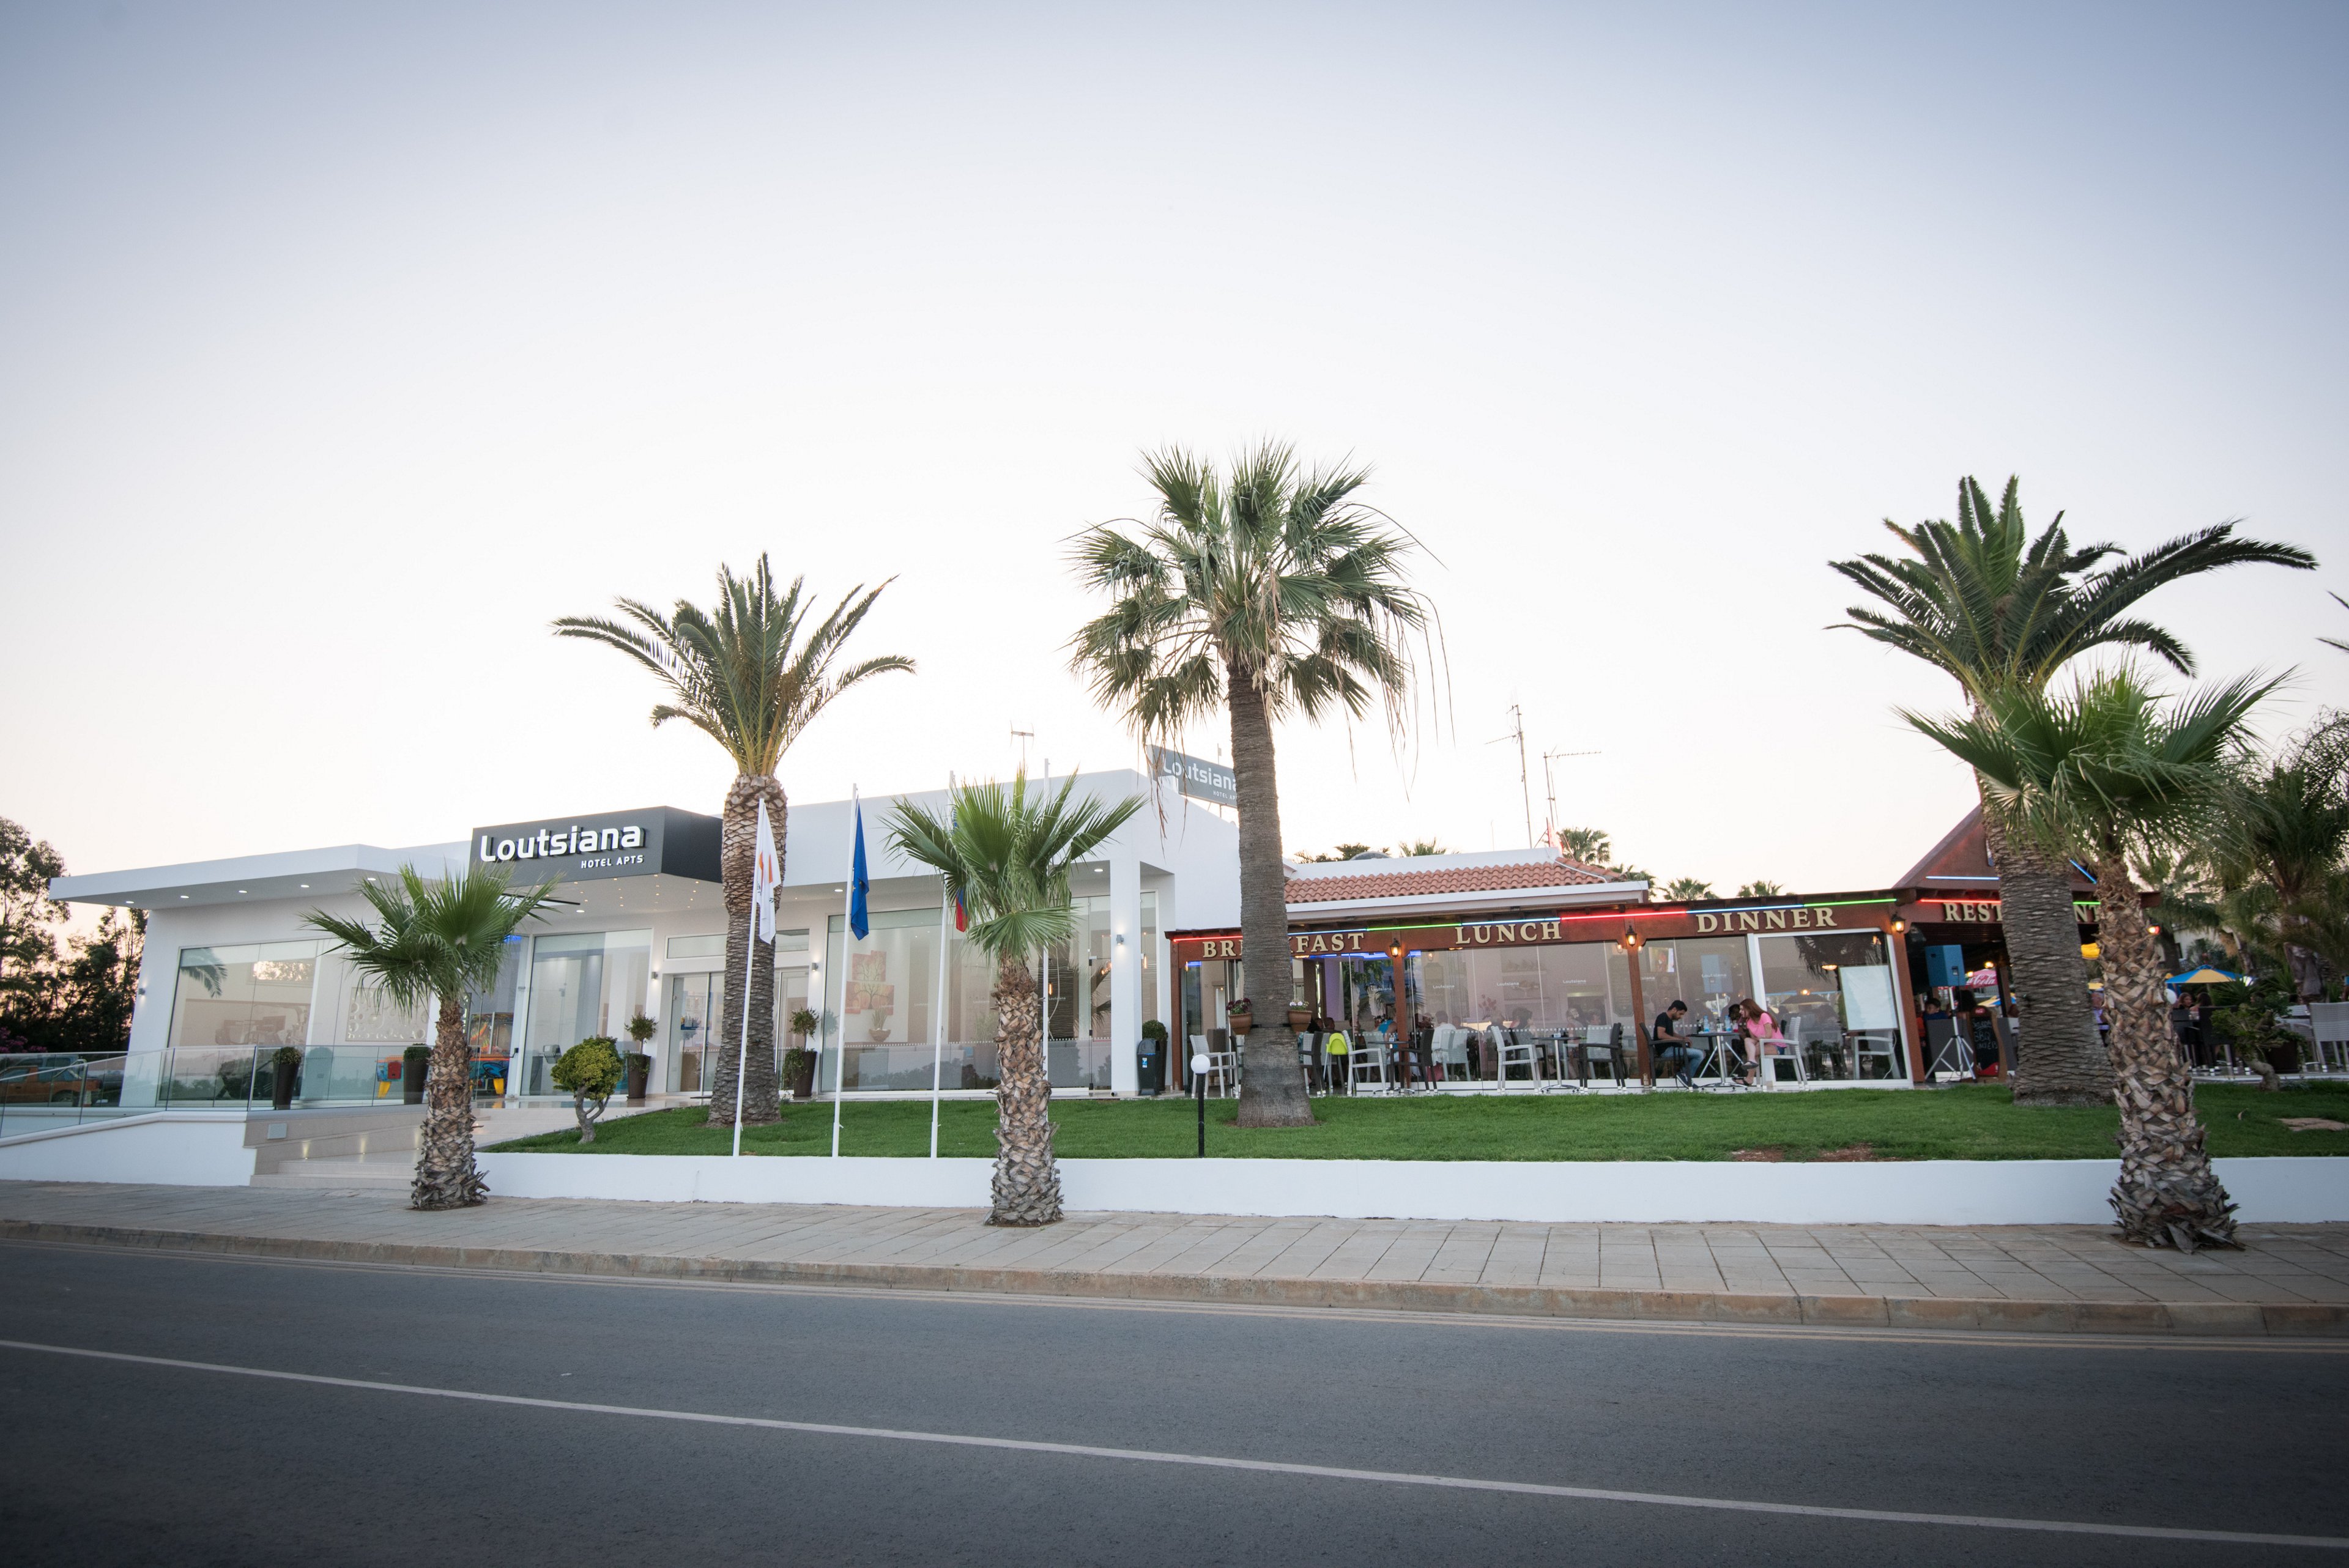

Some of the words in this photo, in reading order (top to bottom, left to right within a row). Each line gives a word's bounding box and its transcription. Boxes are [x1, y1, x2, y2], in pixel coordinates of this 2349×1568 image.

[480, 826, 641, 862] Loutsiana
[581, 858, 612, 869] HOTEL
[617, 855, 644, 865] APTS
[1696, 908, 1837, 933] DINNER
[1943, 902, 2101, 922] RESTNT
[1455, 921, 1562, 944] LUNCH
[1203, 933, 1364, 958] BRFAST
